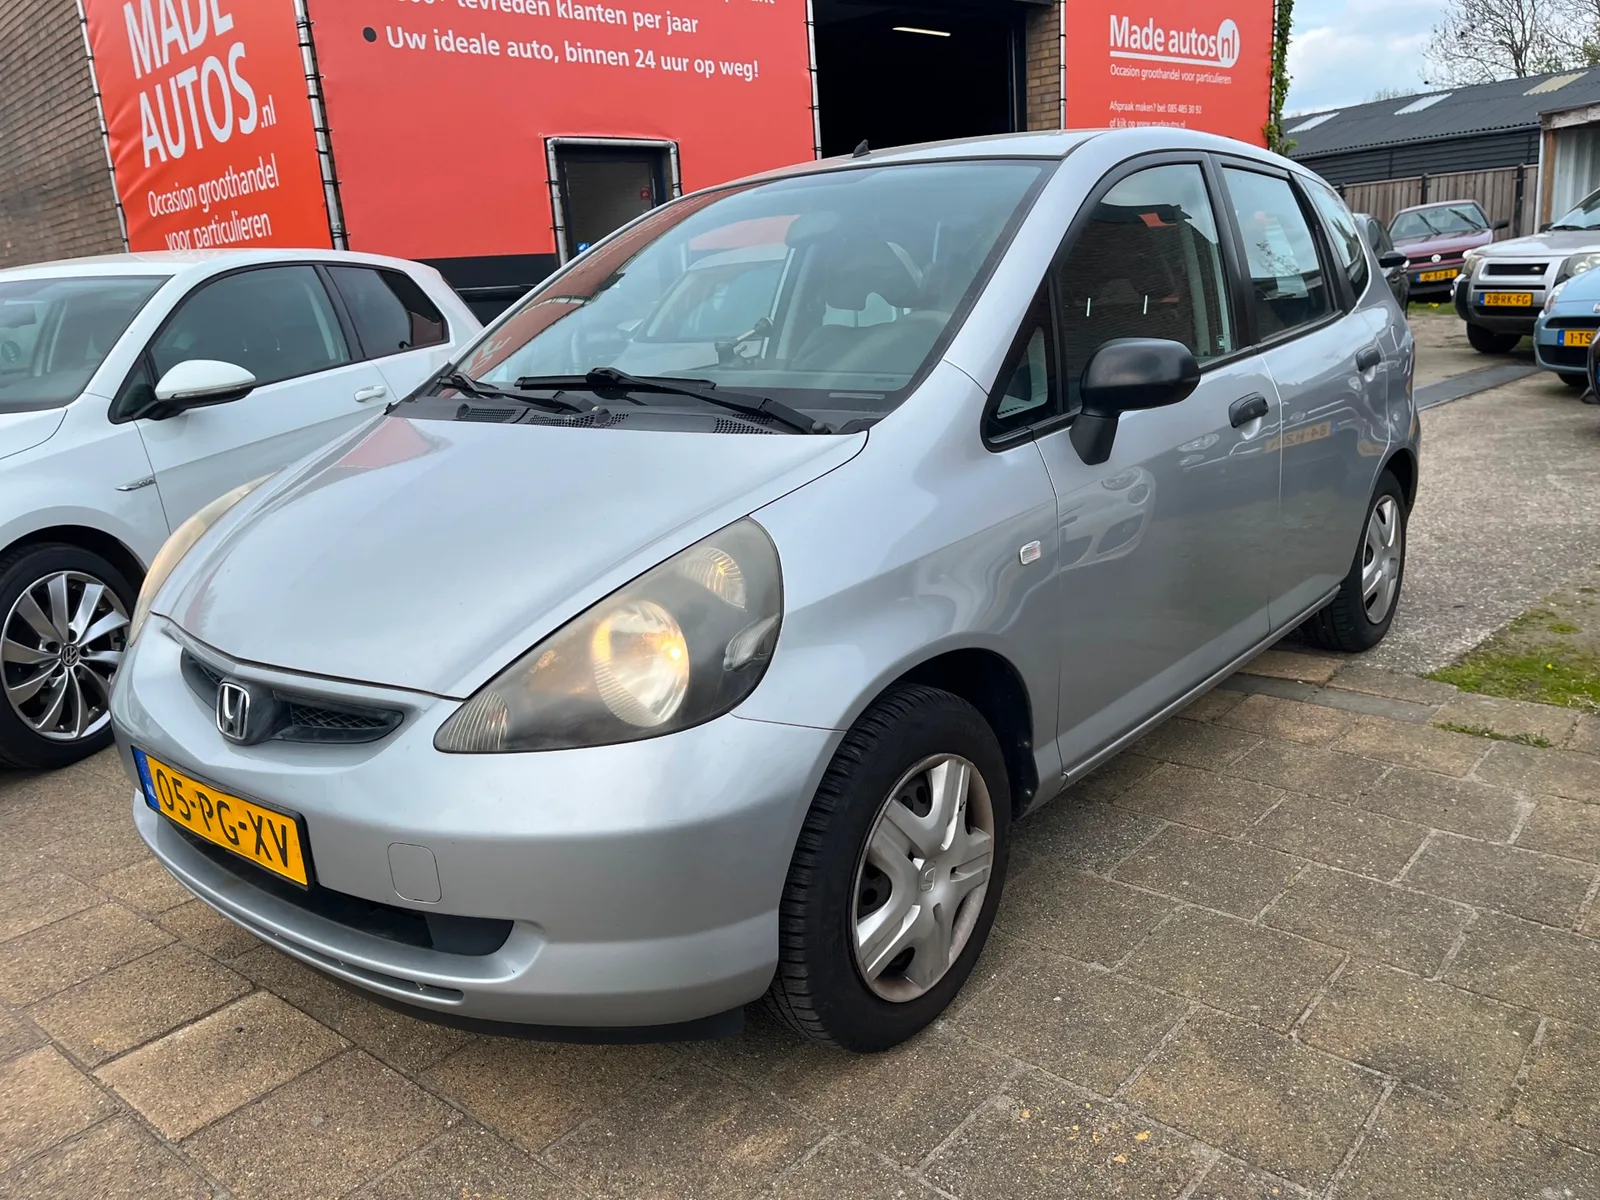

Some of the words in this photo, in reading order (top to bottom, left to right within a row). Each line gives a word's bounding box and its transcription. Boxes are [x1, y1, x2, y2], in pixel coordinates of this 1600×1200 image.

[557, 0, 628, 25] klanten
[632, 11, 662, 32] per
[666, 11, 699, 36] jaar
[1109, 14, 1165, 52] Made
[386, 25, 427, 50] Uw
[433, 28, 501, 56] ideale
[507, 40, 560, 64] auto,
[564, 40, 630, 67] binnen
[634, 48, 656, 69] 24
[660, 55, 690, 73] uur
[694, 58, 716, 79] op
[719, 60, 760, 82] weg!
[1109, 64, 1140, 77] Occasion
[1141, 68, 1180, 80] groothandel
[1181, 72, 1195, 81] voor
[1196, 72, 1232, 84] particulieren
[1109, 101, 1134, 113] Afspraak
[147, 181, 198, 217] Occasion
[198, 152, 280, 214] groothandel
[164, 229, 192, 250] voor
[193, 210, 273, 250] particulieren
[1570, 332, 1595, 345] 1-TS
[156, 768, 289, 869] 05-PG-XV
